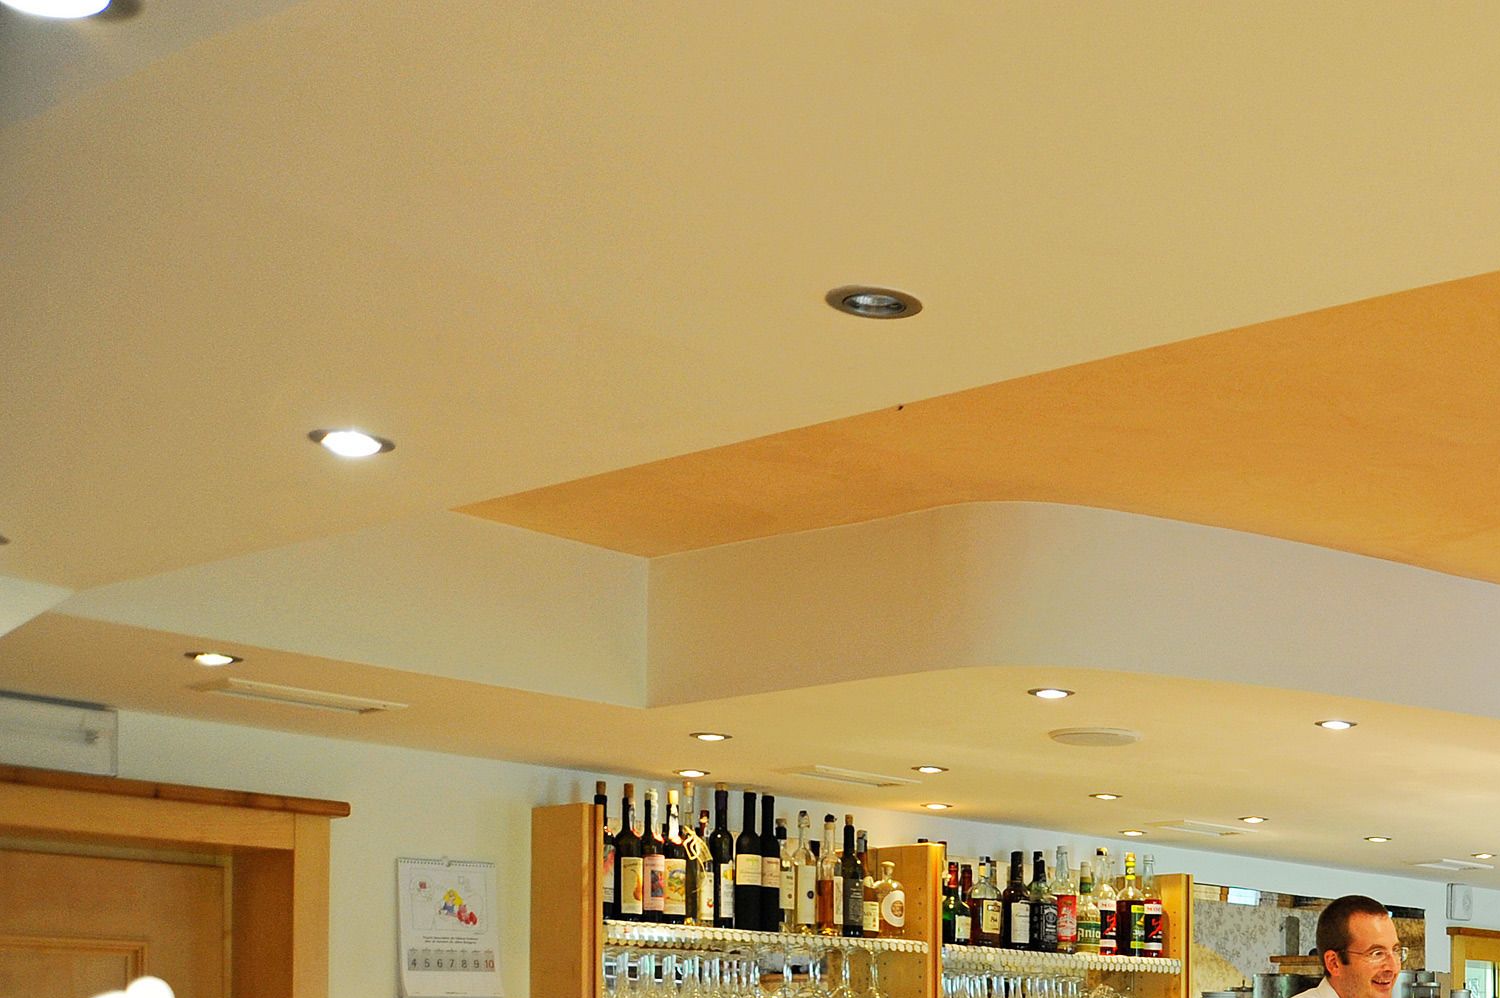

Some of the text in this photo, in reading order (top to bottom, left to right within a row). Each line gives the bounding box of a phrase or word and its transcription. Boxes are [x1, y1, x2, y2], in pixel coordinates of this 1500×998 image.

[411, 958, 495, 968] 4 5 6 7 8 9 10
